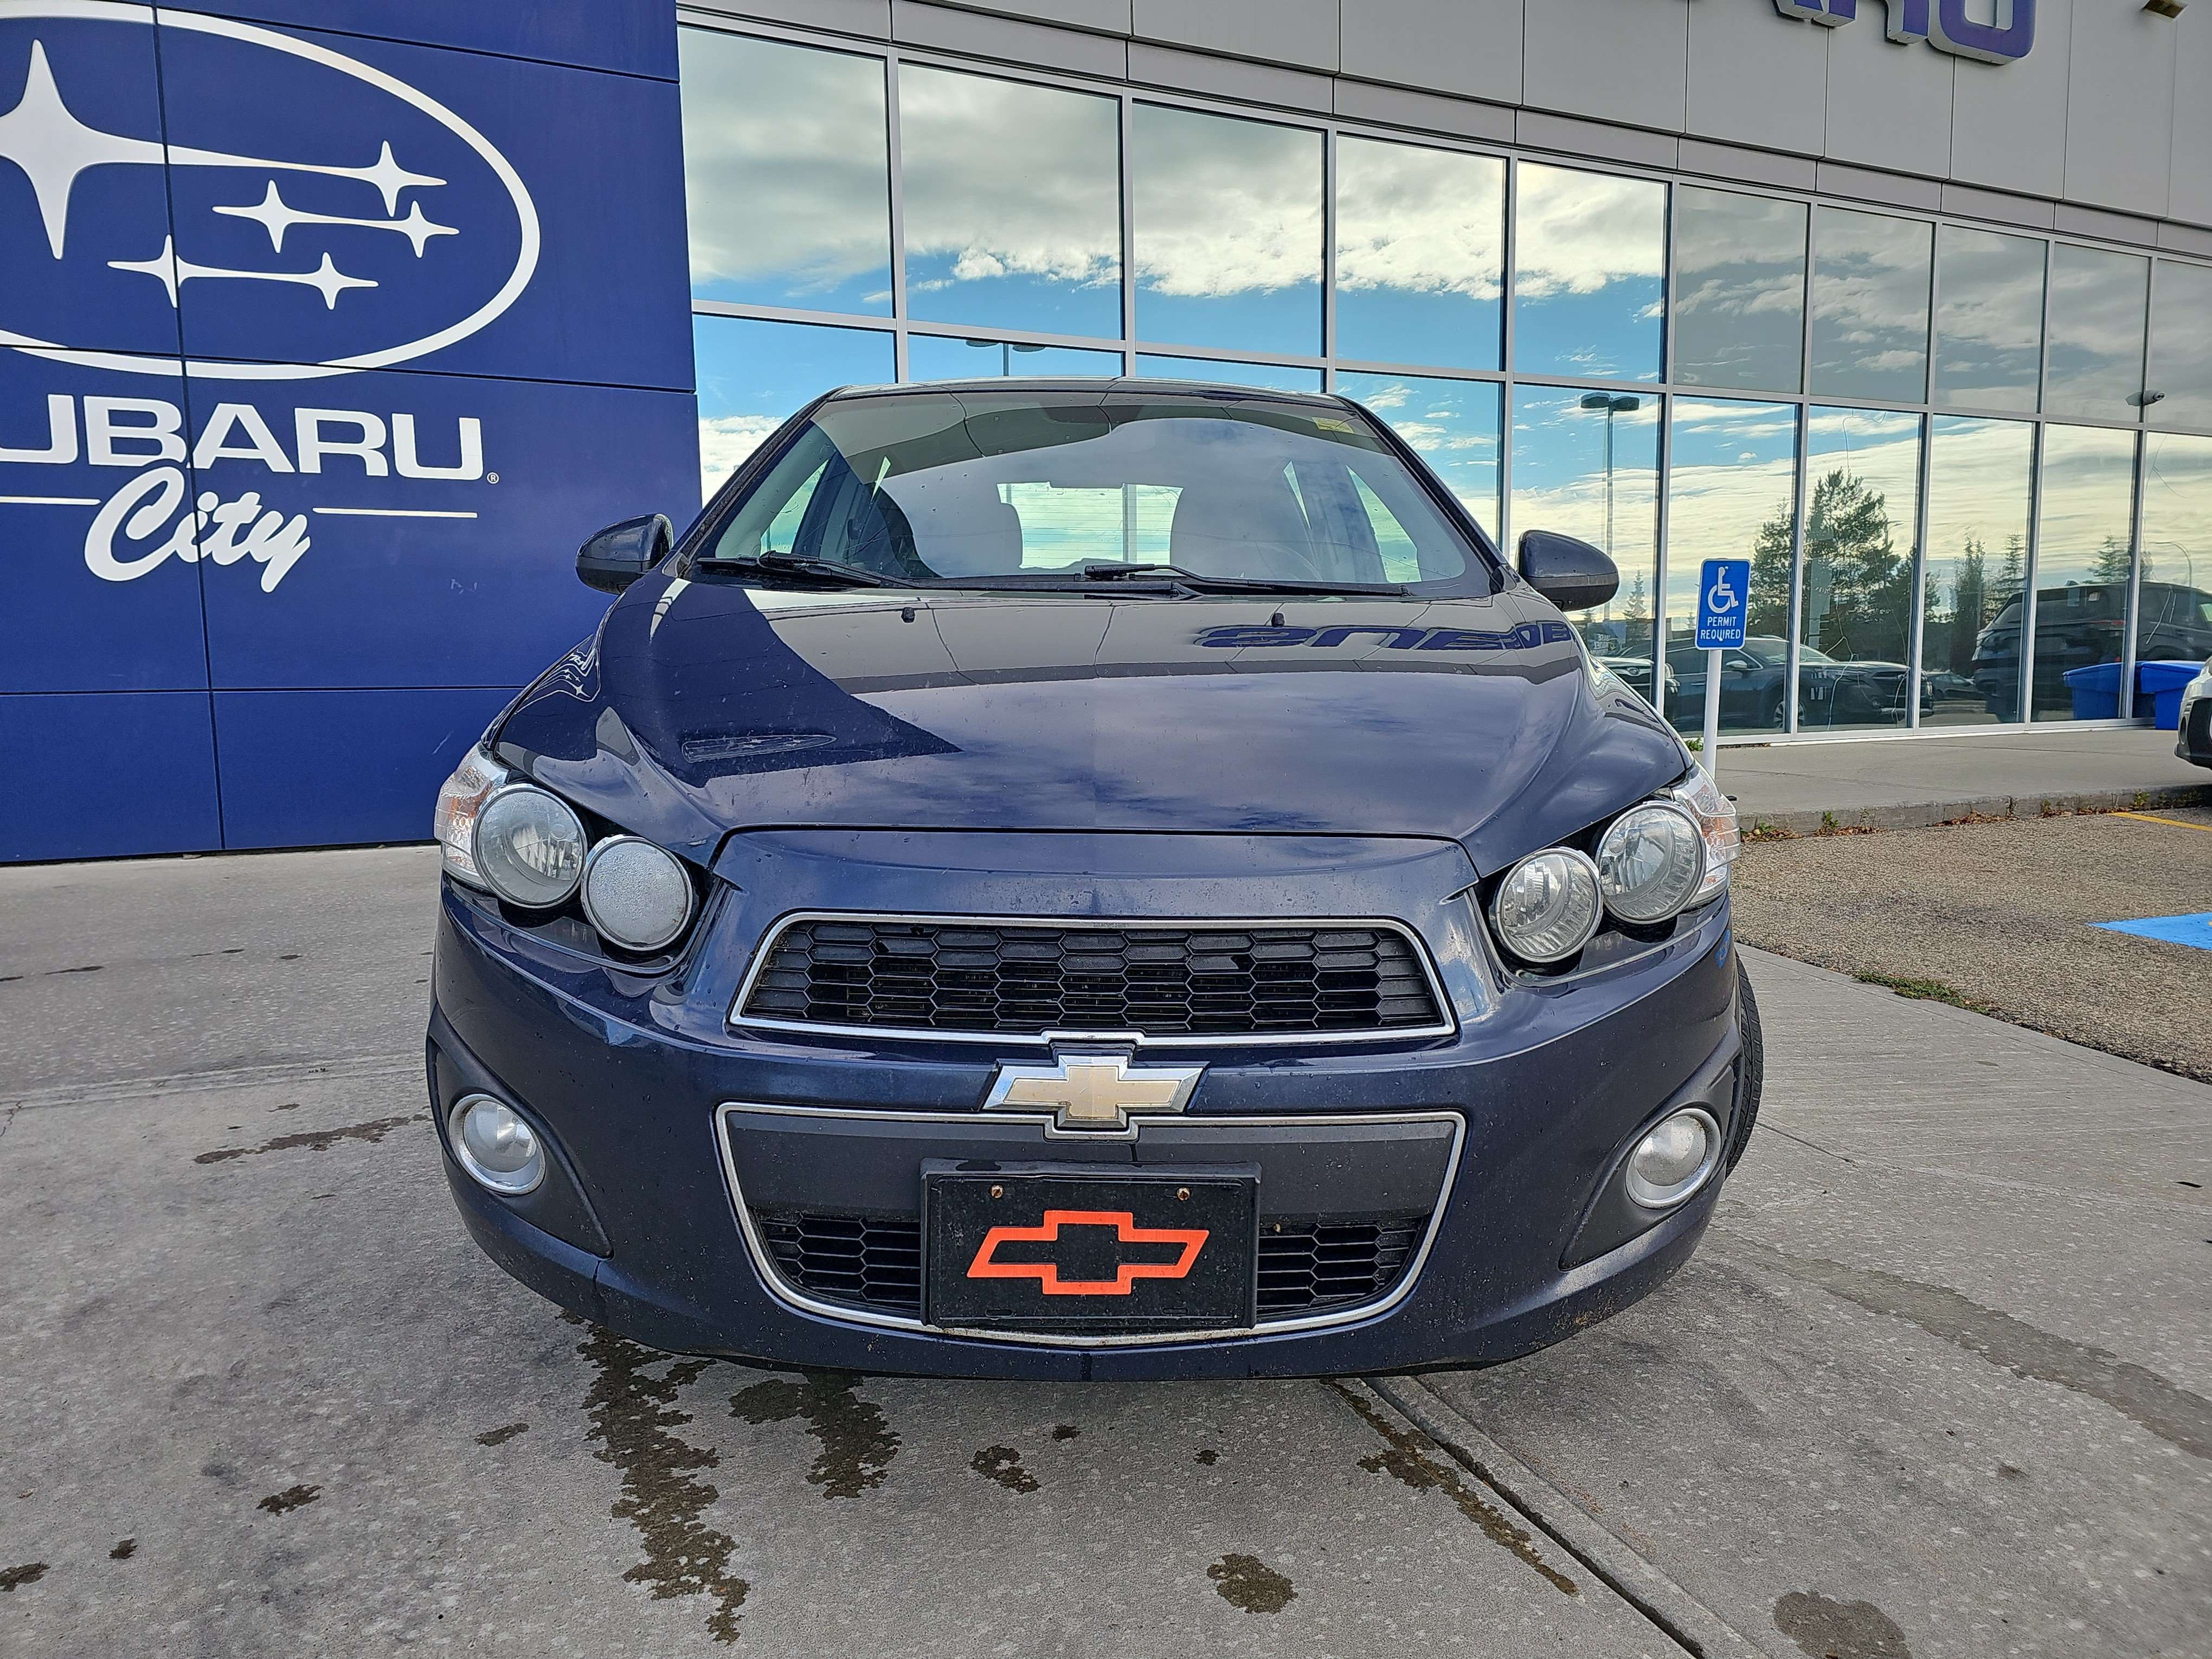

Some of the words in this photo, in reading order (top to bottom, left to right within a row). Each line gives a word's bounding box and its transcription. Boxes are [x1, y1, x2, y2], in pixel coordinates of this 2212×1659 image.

[84, 466, 311, 593] City
[1707, 616, 1737, 627] PERMIT
[1700, 629, 1740, 640] REQUIRED
